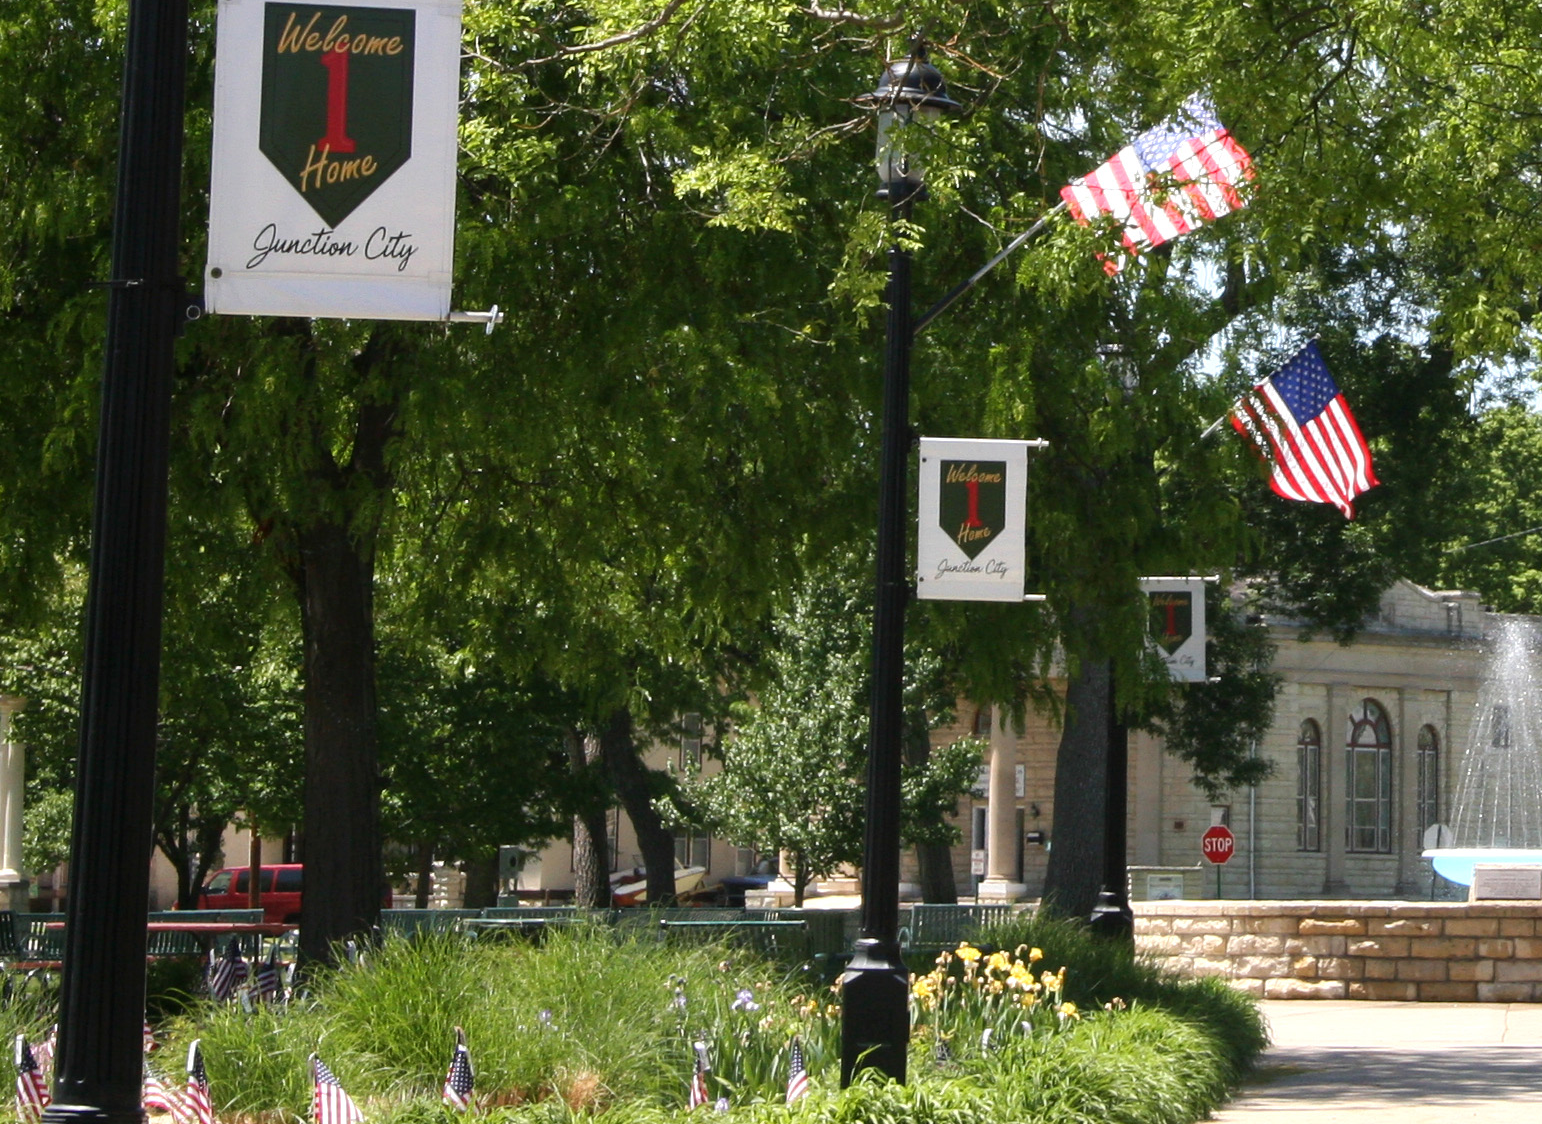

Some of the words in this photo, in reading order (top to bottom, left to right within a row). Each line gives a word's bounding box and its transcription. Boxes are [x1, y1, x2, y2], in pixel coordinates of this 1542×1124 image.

[277, 12, 403, 56] Welcome
[320, 46, 356, 154] 1
[300, 143, 378, 192] Home
[246, 222, 359, 269] Junction
[365, 226, 419, 272] City
[946, 463, 1002, 484] Welcome
[965, 481, 982, 527] 1
[957, 522, 991, 544] Home
[934, 558, 983, 579] Junction
[985, 558, 1009, 579] City
[1204, 837, 1232, 852] STOP
